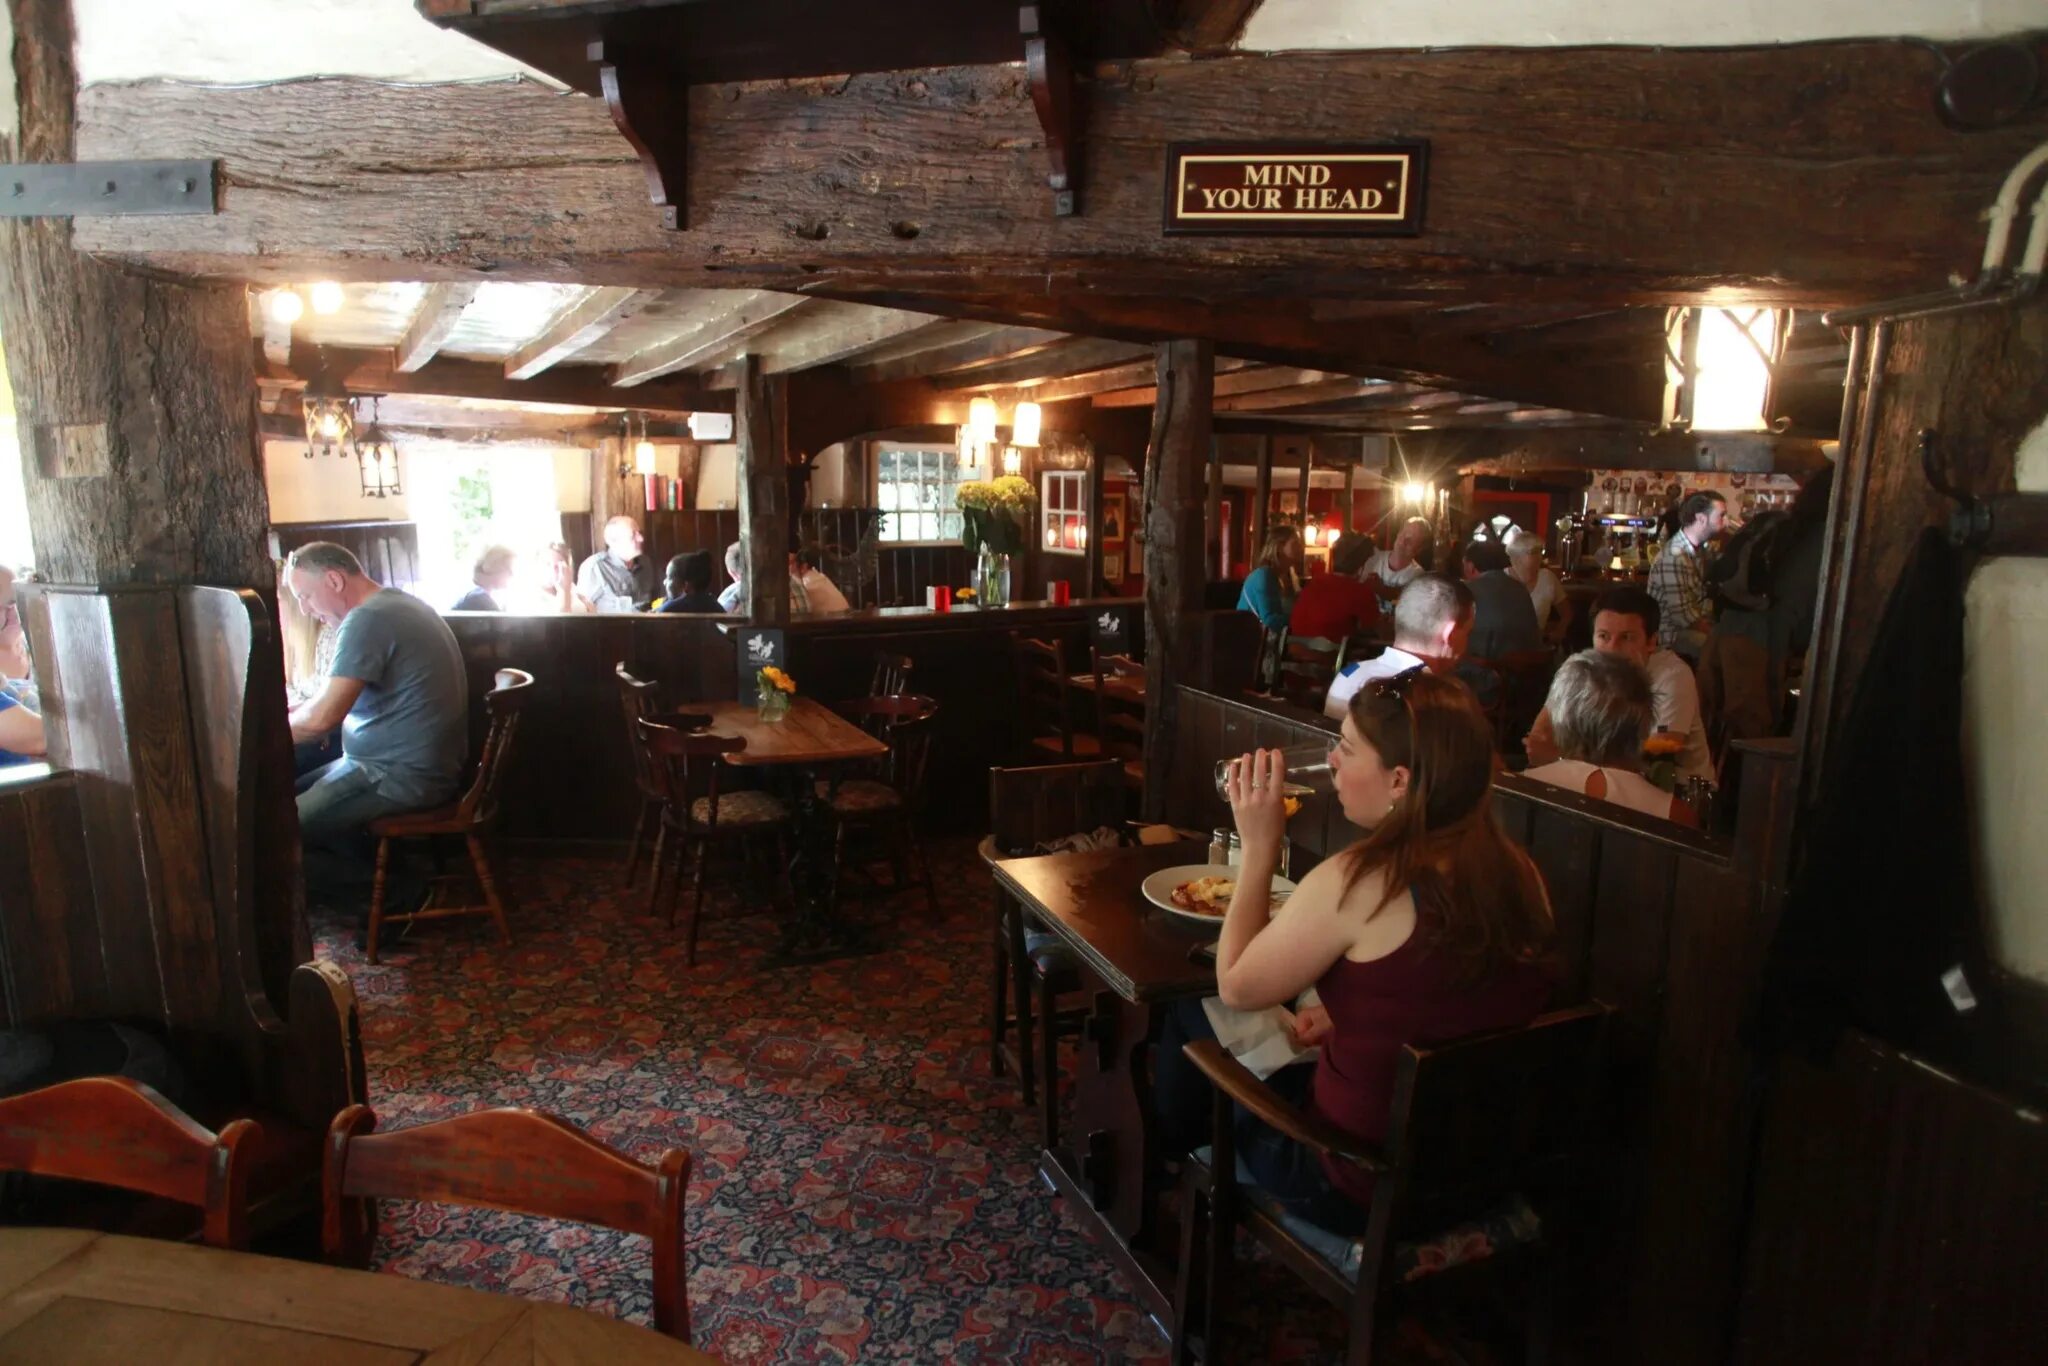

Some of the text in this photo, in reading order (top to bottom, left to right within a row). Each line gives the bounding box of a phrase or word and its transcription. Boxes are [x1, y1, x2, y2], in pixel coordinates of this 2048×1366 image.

[1243, 164, 1331, 186] MIND
[1202, 188, 1383, 210] YOUR HEAD
